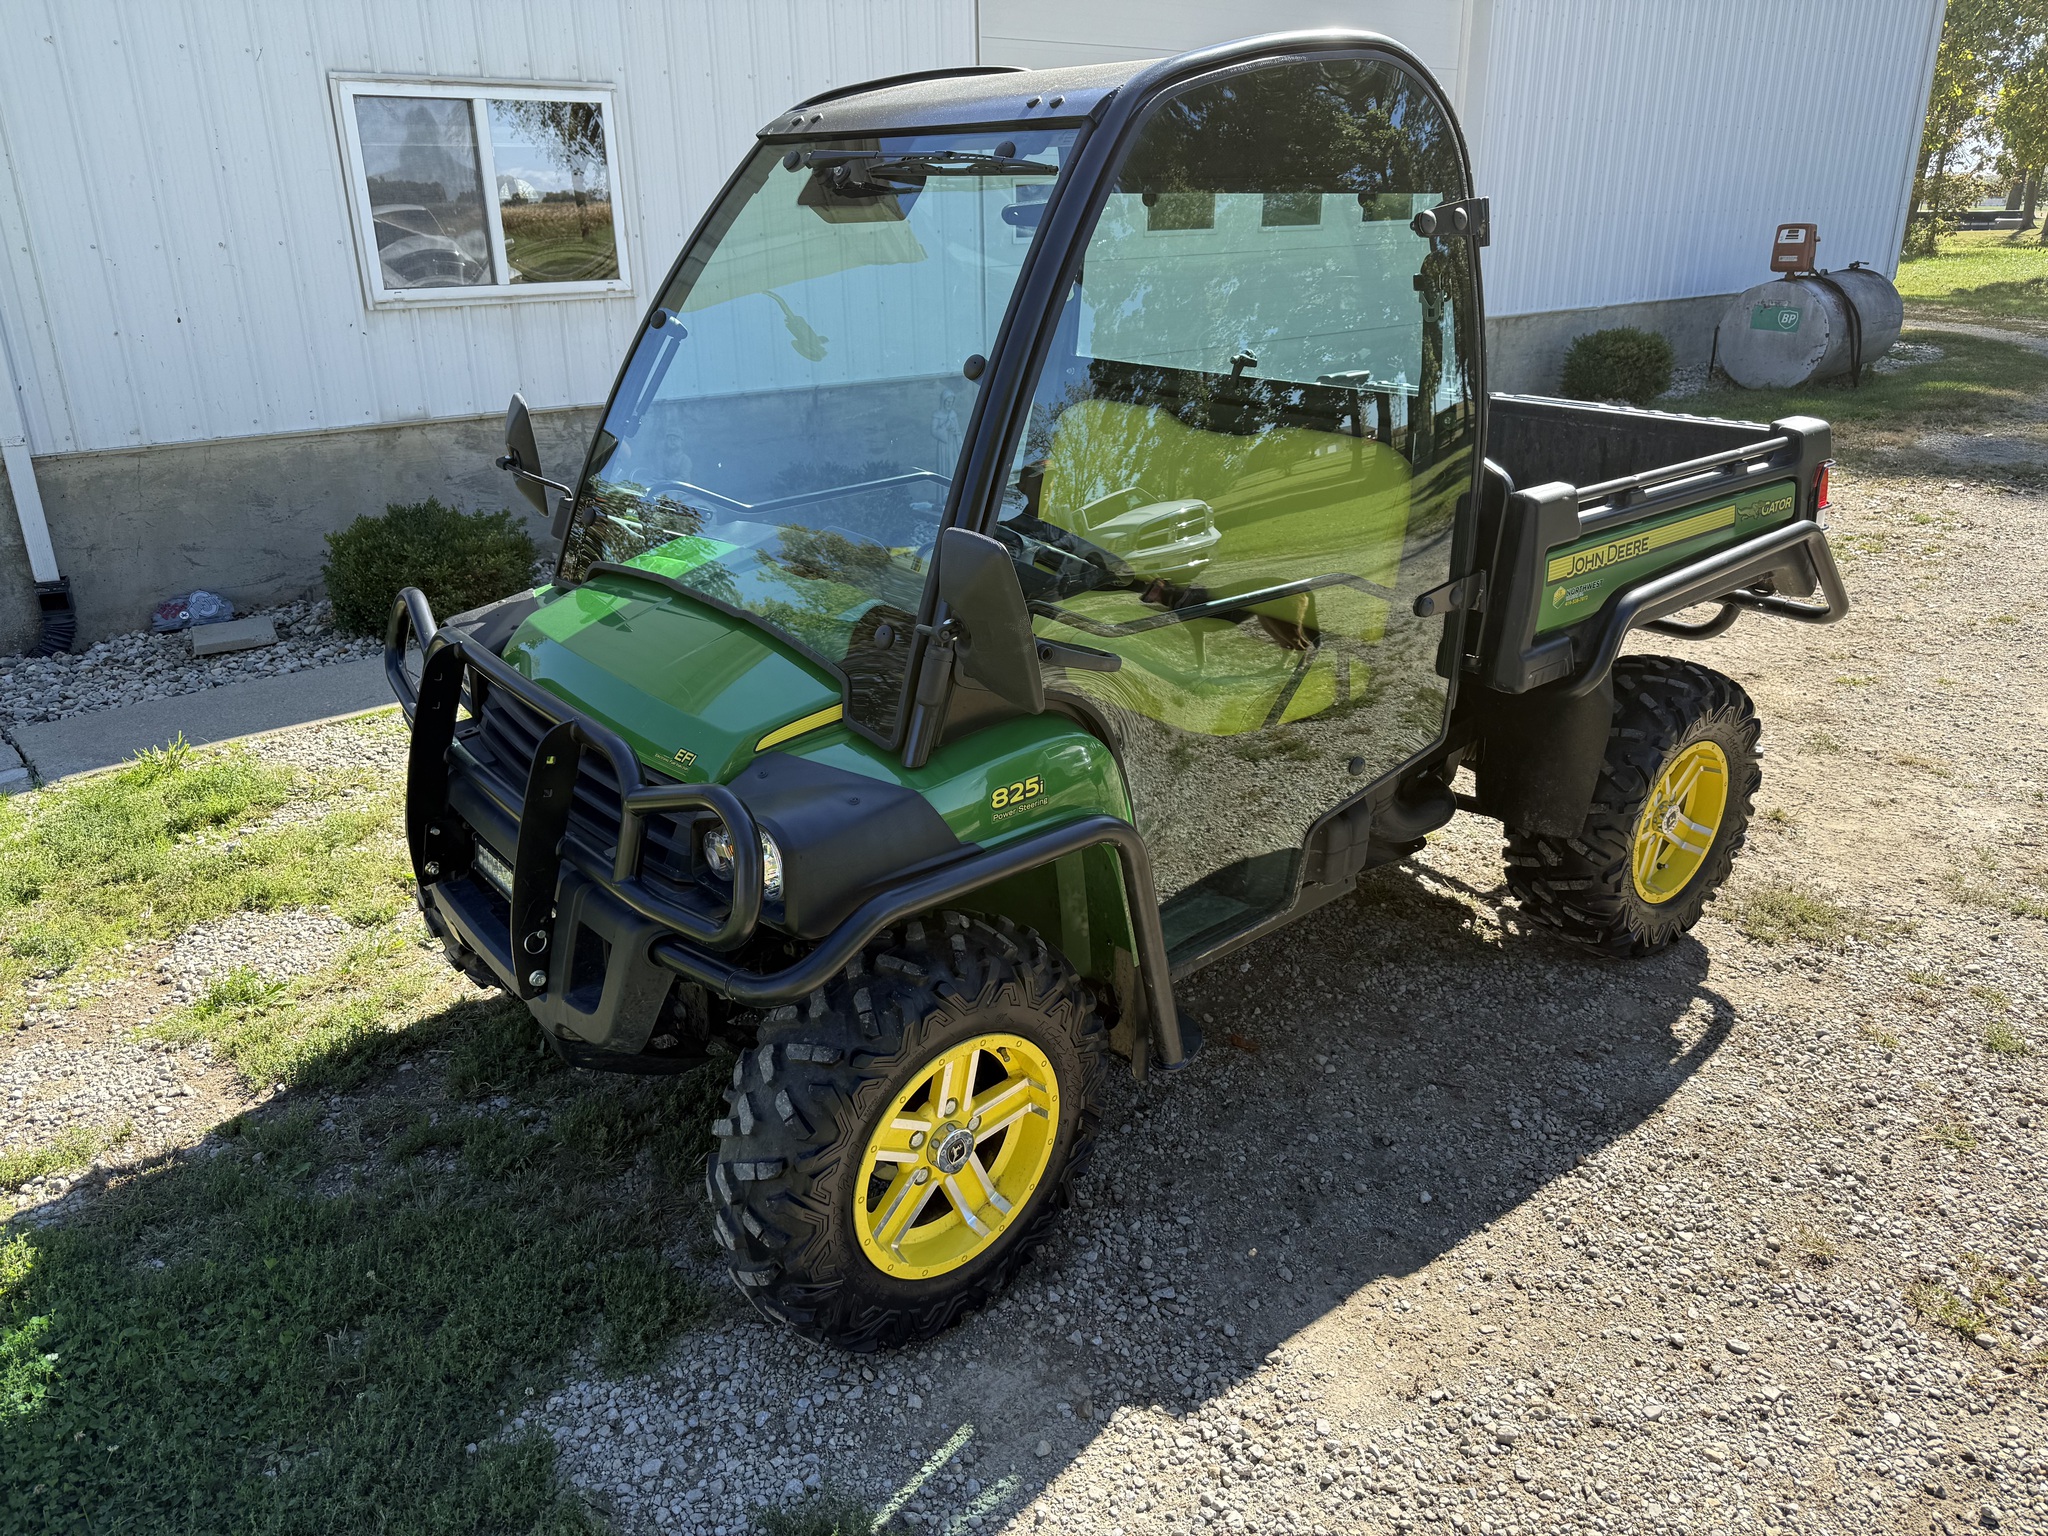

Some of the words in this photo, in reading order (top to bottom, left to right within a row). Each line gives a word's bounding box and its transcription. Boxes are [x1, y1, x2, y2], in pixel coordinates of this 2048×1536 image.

[1781, 313, 1796, 324] BP
[1761, 496, 1793, 516] GATOR
[1566, 551, 1605, 577] JOHN
[1607, 536, 1650, 563] DEERE
[1566, 579, 1605, 597] NORTHWEST
[673, 748, 698, 767] EFI
[991, 775, 1044, 810] 825i
[992, 808, 1017, 822] Power
[1018, 797, 1048, 813] Steering
